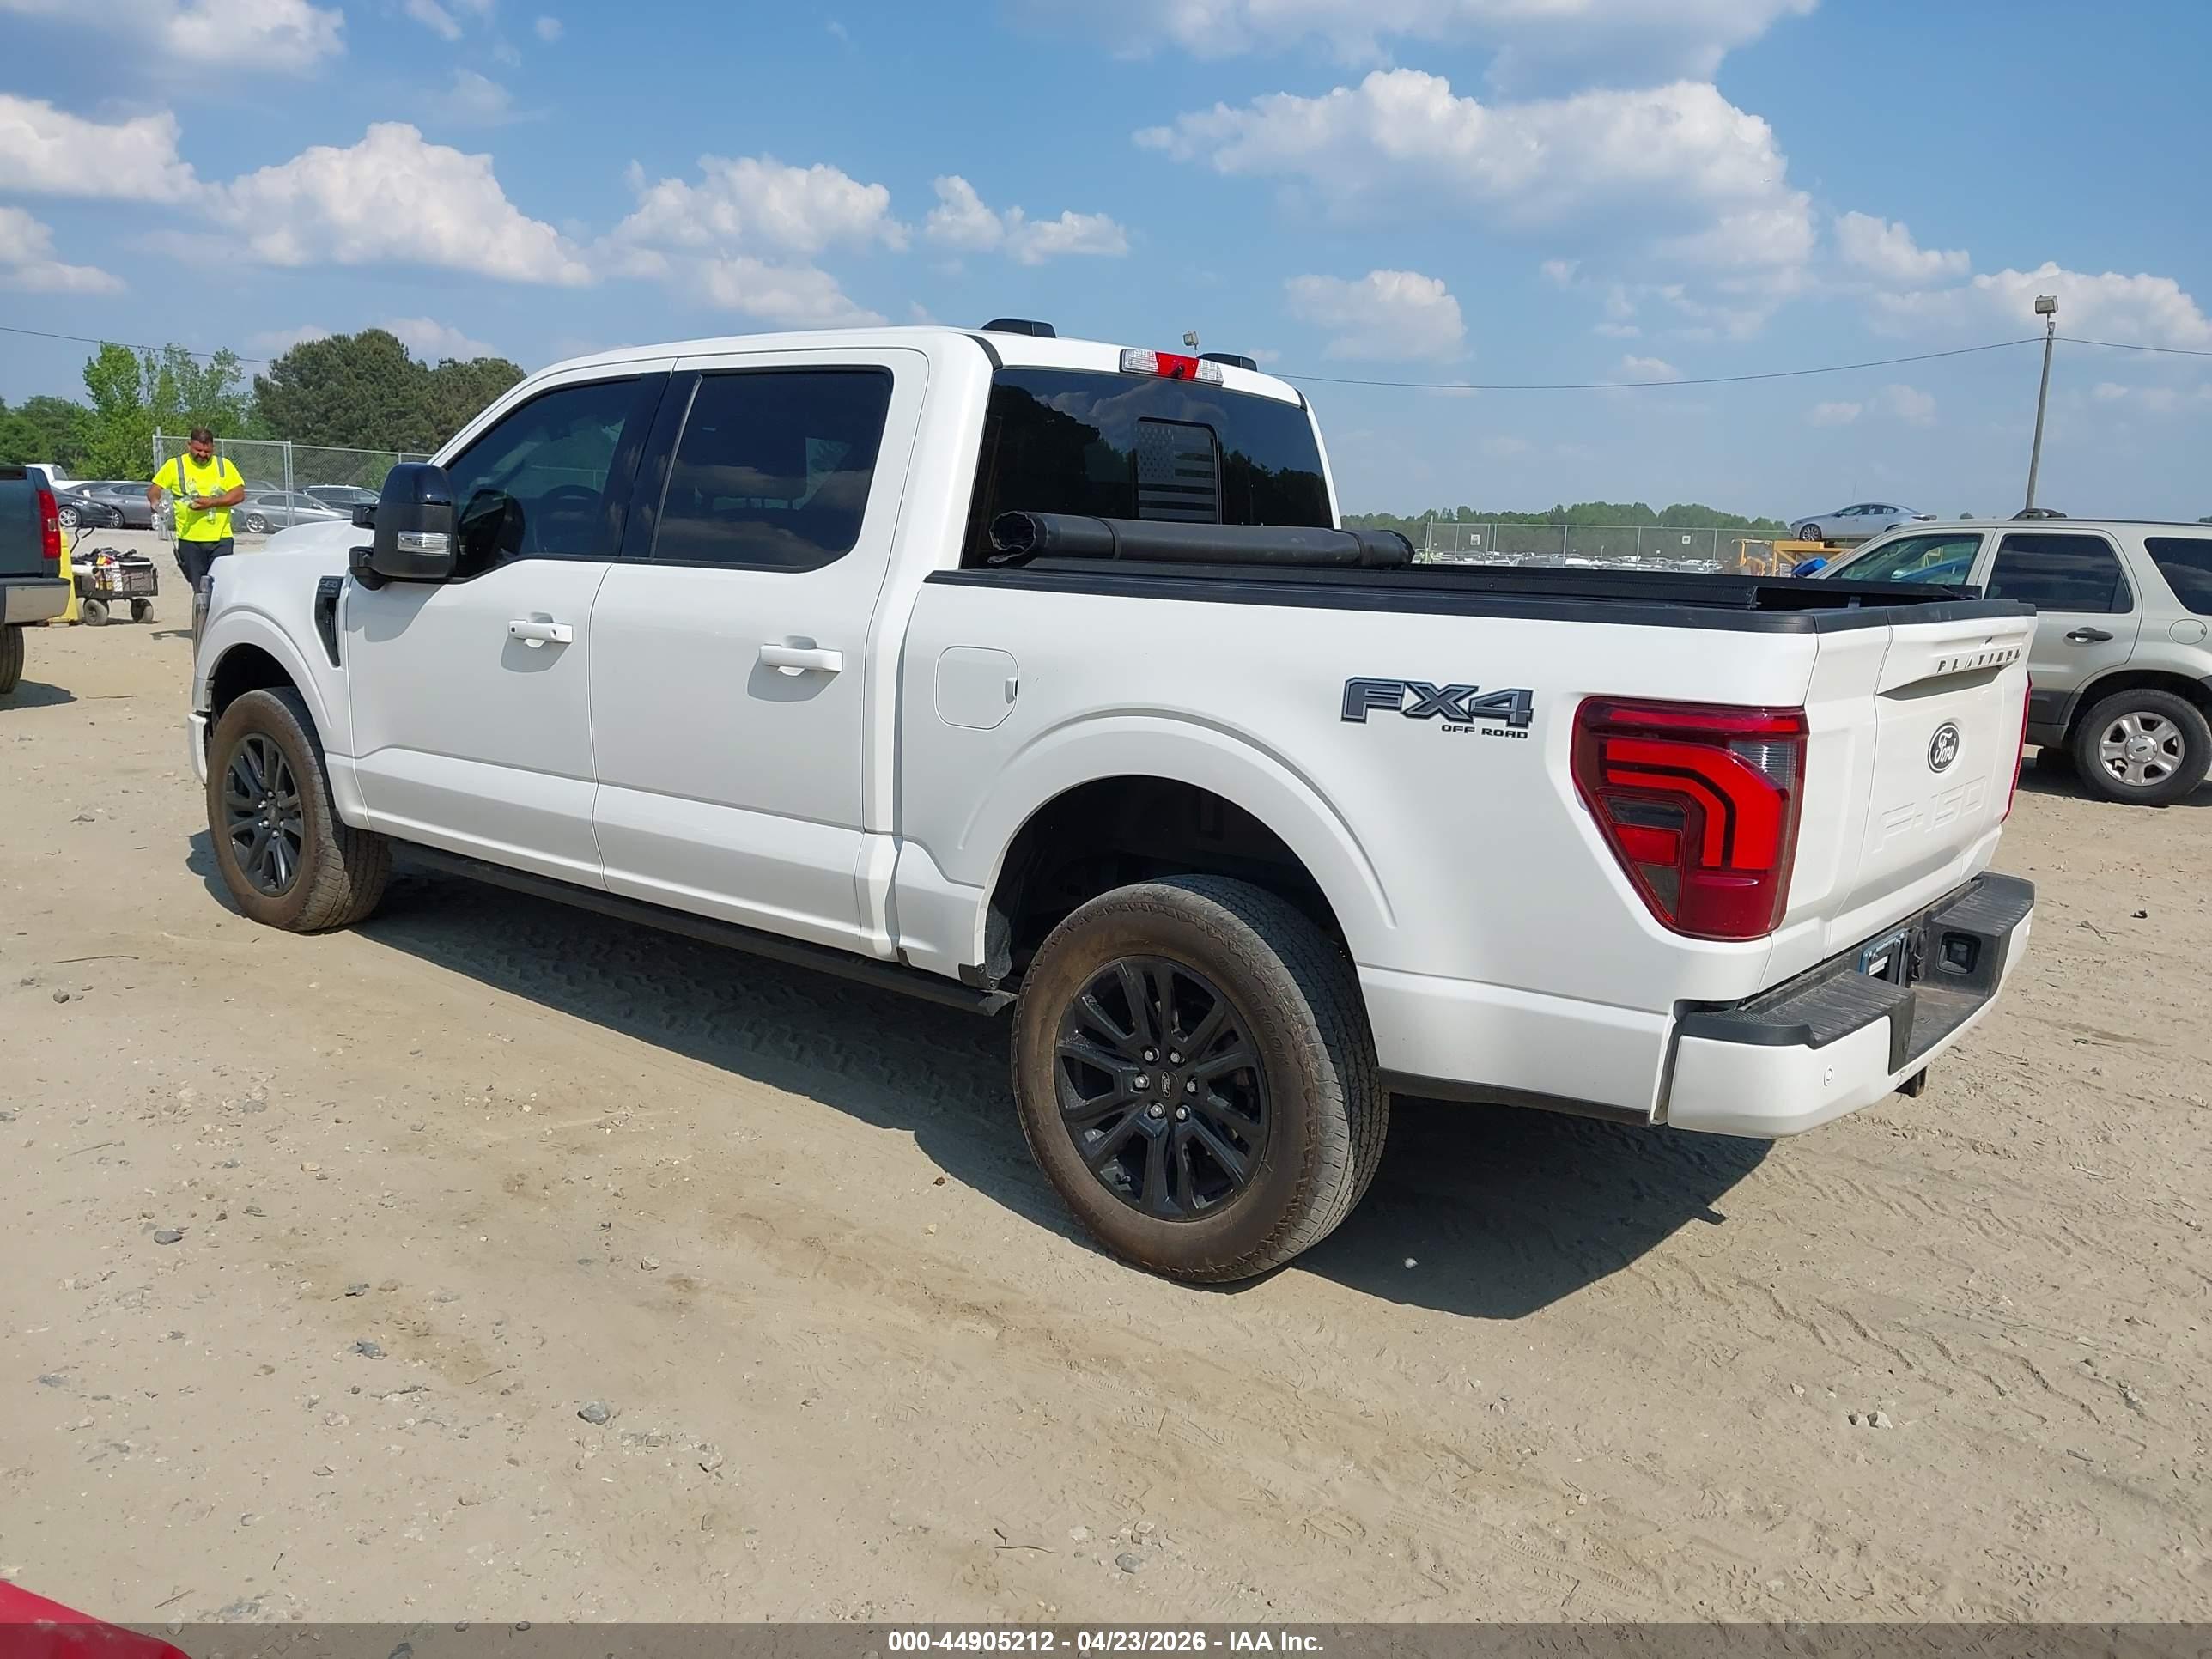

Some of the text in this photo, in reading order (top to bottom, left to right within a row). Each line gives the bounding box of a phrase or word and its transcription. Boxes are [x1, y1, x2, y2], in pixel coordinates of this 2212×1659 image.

[1340, 677, 1534, 728] FX4
[1442, 725, 1528, 739] OFF ROAD
[1934, 731, 1957, 765] Ford
[1872, 775, 1986, 854] F-150
